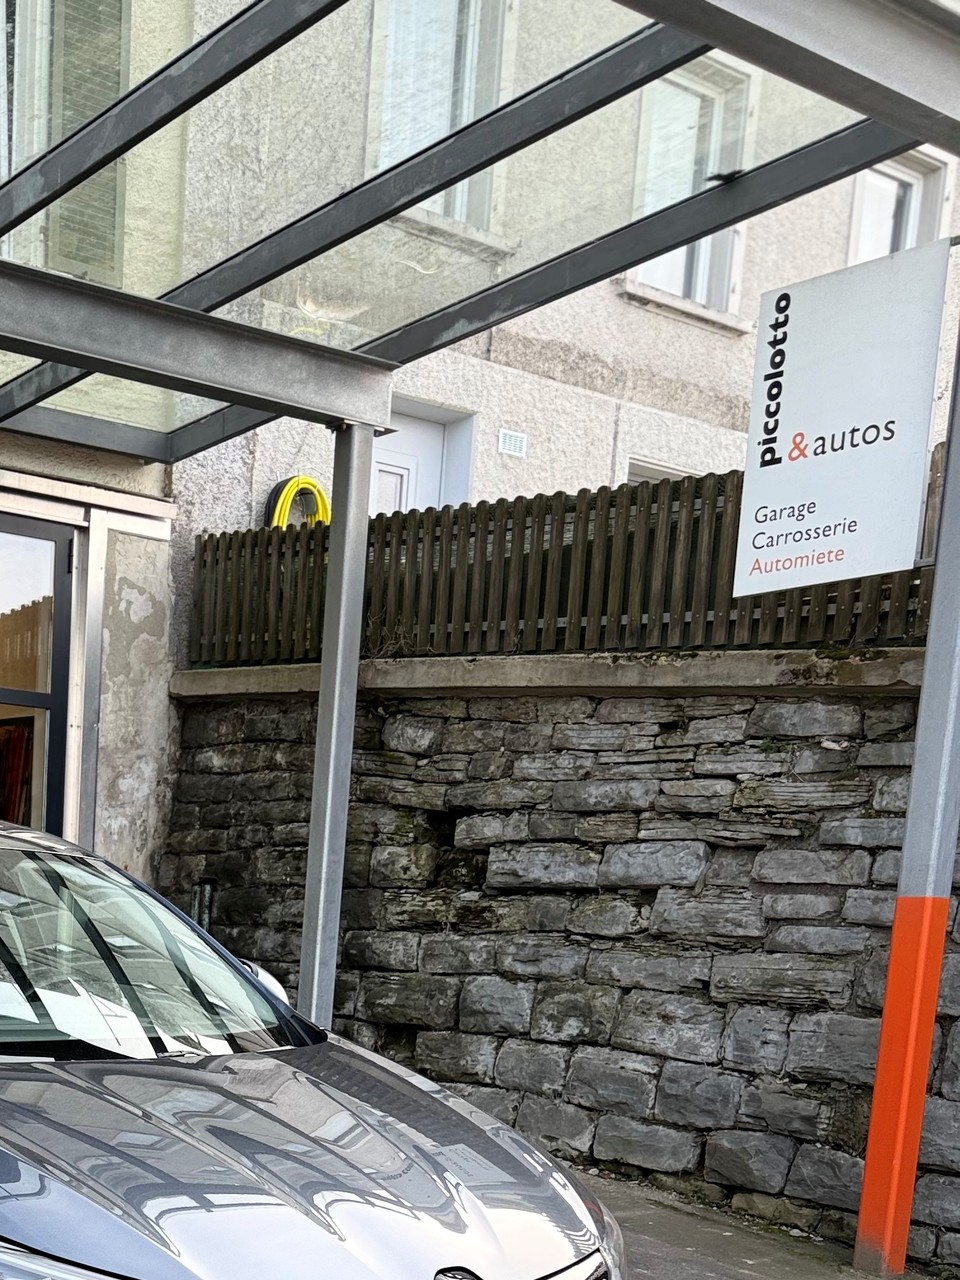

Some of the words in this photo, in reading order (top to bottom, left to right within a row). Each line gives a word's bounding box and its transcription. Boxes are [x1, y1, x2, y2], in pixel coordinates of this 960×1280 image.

[758, 292, 791, 468] piccolotto
[754, 500, 817, 524] Garage
[752, 518, 858, 550] Carrosserie
[749, 547, 846, 577] Automiete
